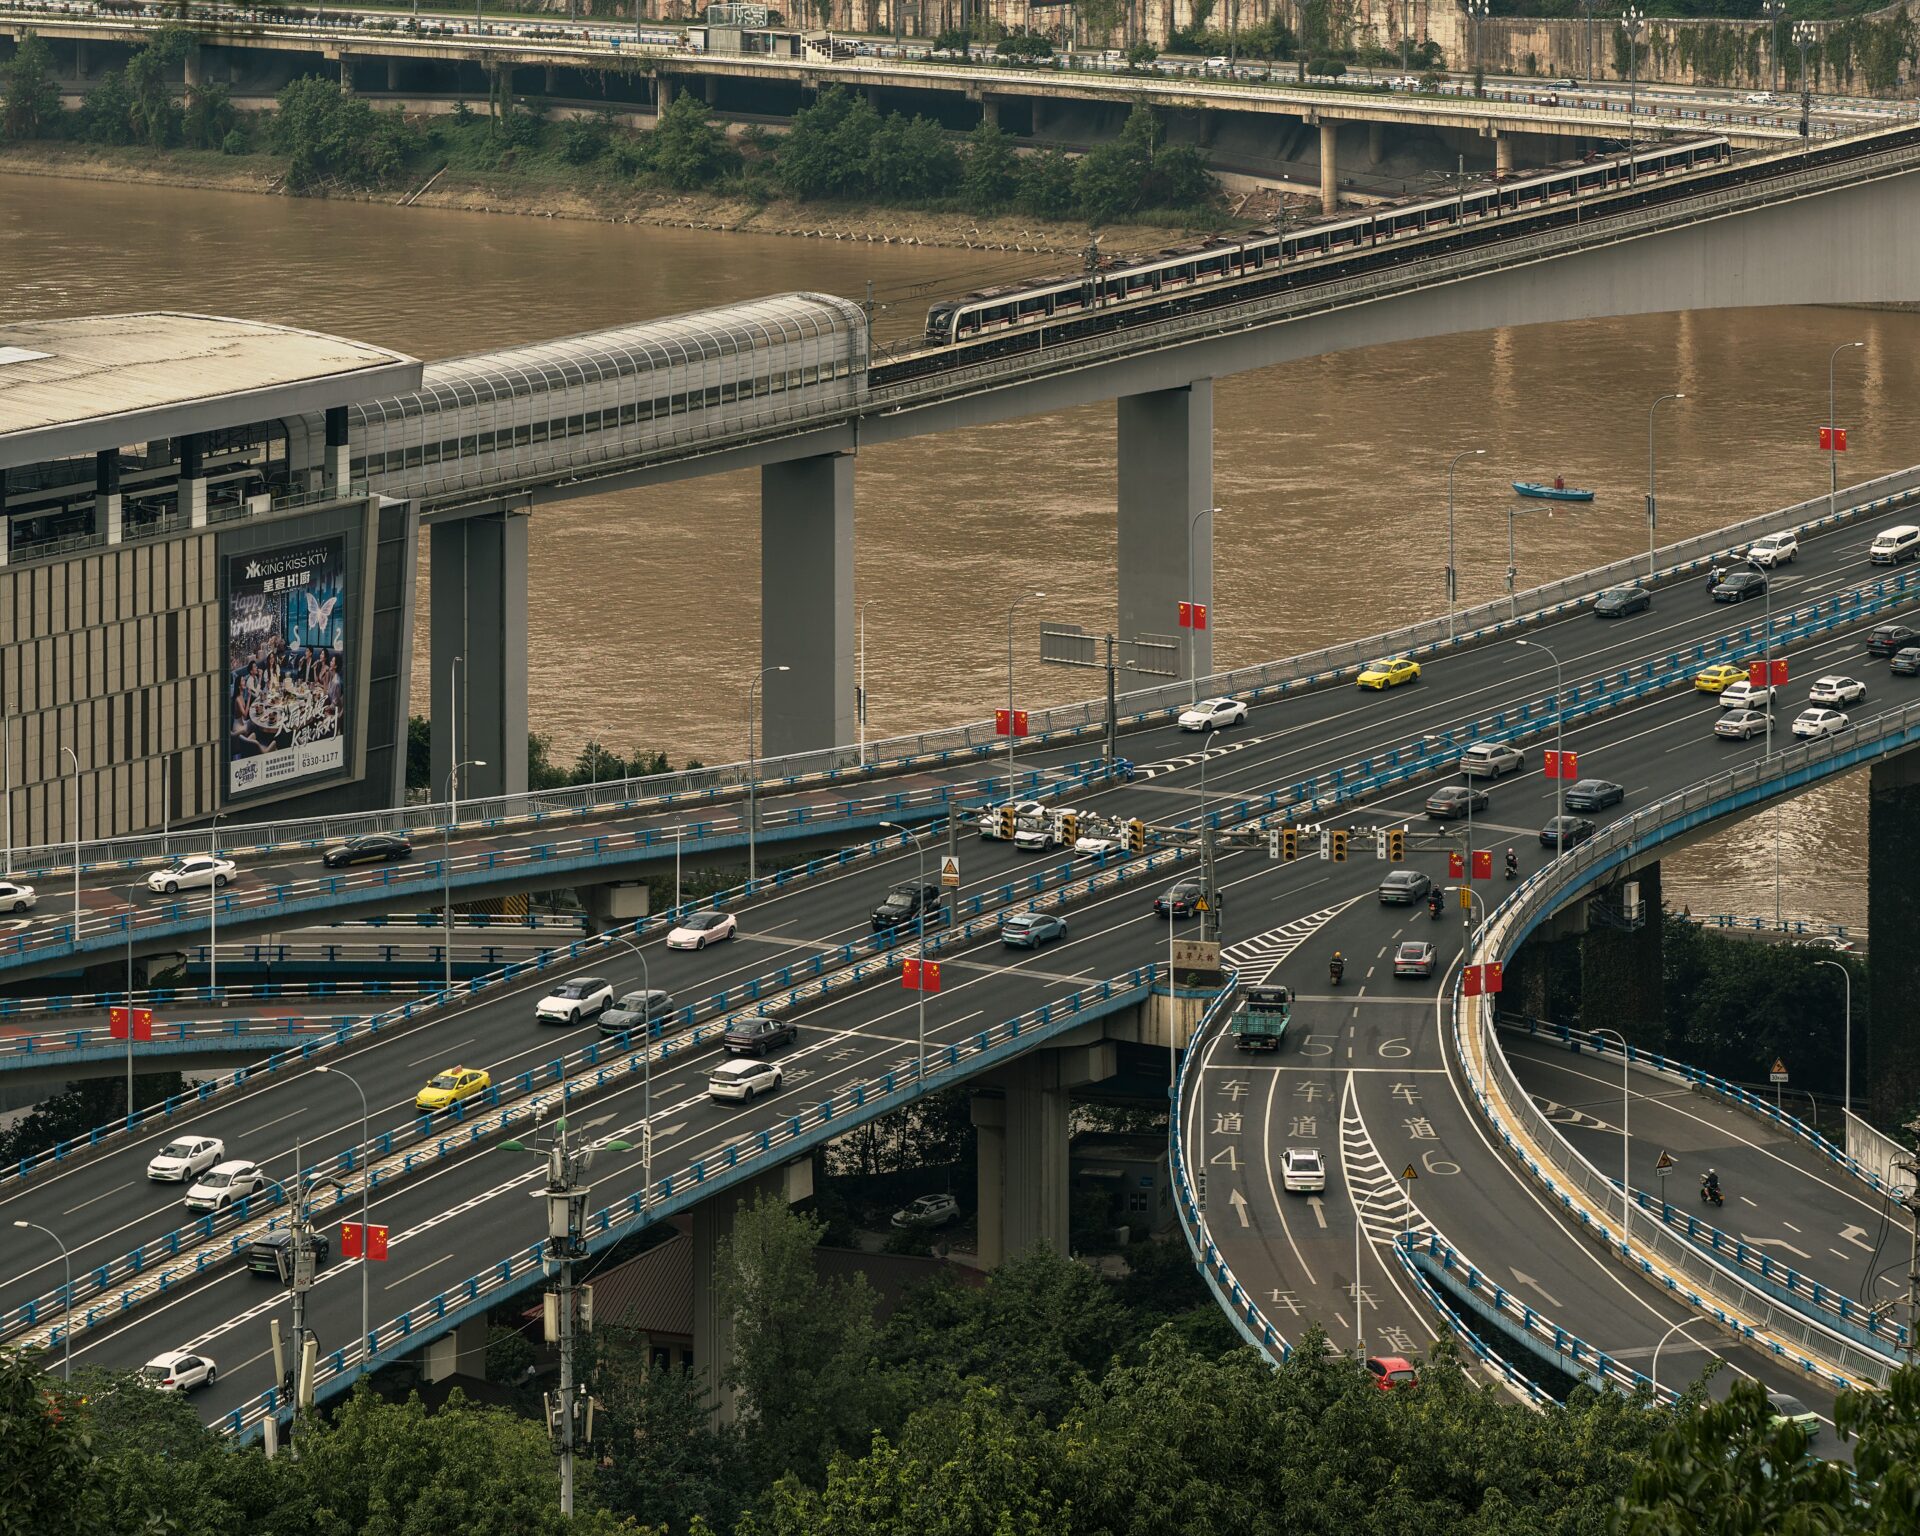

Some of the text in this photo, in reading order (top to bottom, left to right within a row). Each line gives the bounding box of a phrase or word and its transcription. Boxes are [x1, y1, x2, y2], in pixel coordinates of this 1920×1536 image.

[260, 552, 328, 577] KING KISS KTV
[231, 592, 266, 613] Happy
[302, 751, 339, 768] 6330-1177
[1299, 1034, 1340, 1057] 5
[1378, 1037, 1412, 1059] 6
